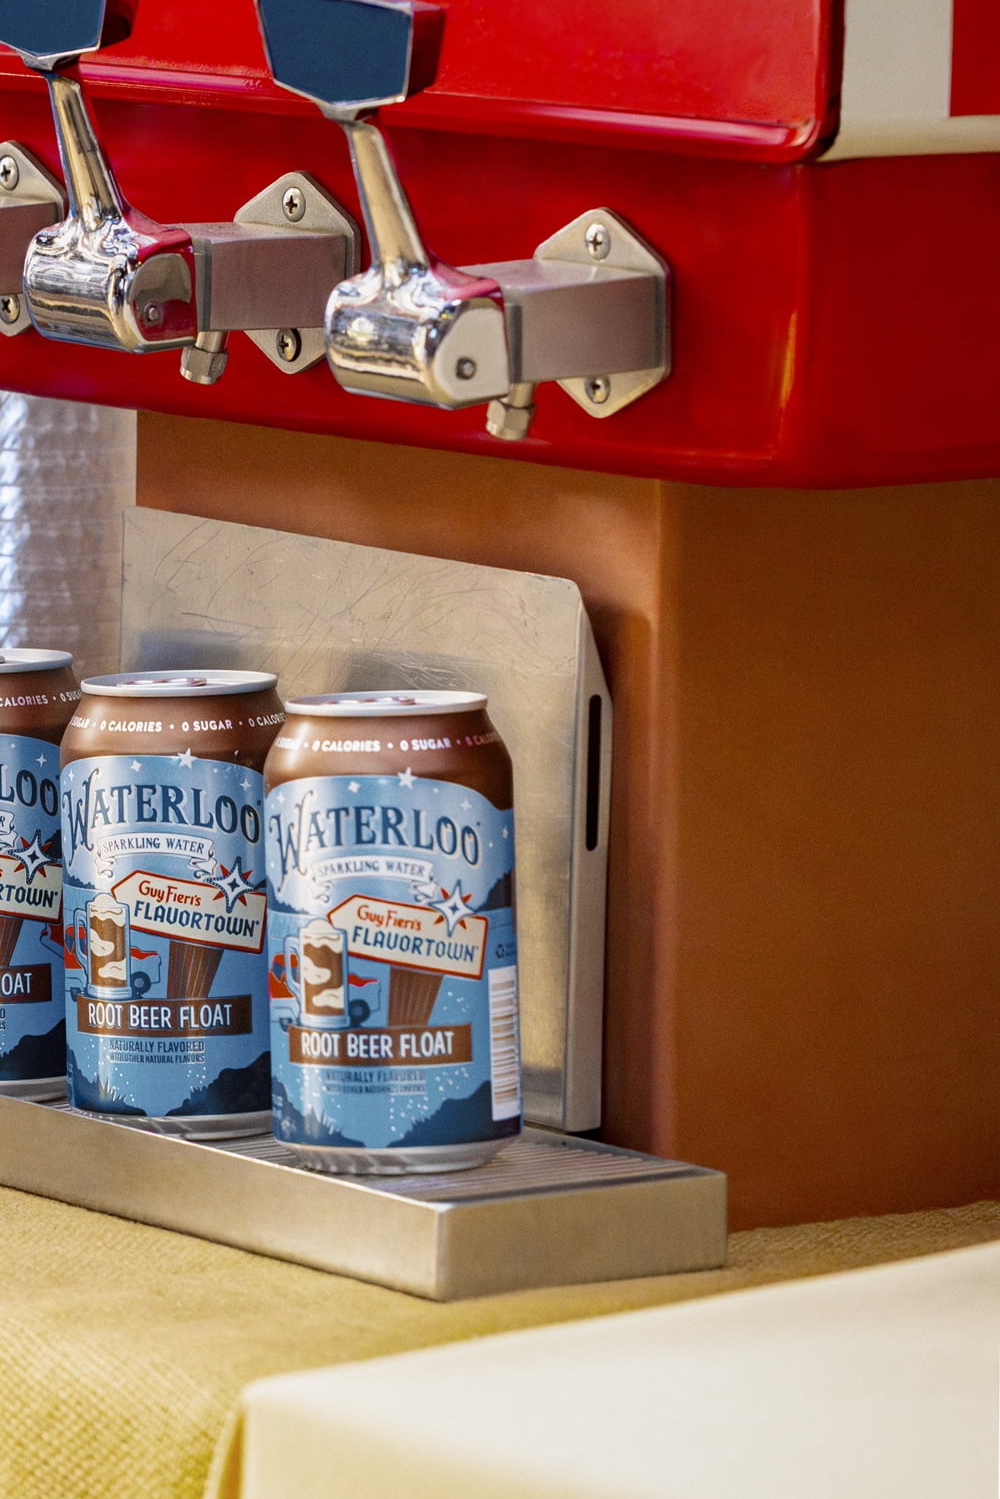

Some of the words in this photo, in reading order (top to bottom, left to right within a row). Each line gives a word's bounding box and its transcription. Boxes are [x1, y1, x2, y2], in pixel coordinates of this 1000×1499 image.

[100, 720, 106, 730] 0
[109, 721, 162, 732] CALORIES
[182, 721, 189, 731] 0
[193, 720, 233, 731] SUGAR
[248, 718, 255, 727] 0
[321, 740, 381, 751] CALORIES
[412, 738, 452, 750] SUGAR
[62, 767, 260, 867] WATERLOO
[103, 837, 160, 852] SPARKLING
[166, 838, 204, 854] WATER
[269, 790, 481, 895] WATERLOO
[318, 860, 380, 877] SPARKLING
[386, 861, 426, 876] WATER
[138, 880, 165, 899] Guy
[357, 905, 383, 926] Guy
[88, 1003, 123, 1028] ROOT
[129, 1004, 172, 1028] BEER
[179, 1003, 232, 1028] FLOAT
[110, 1041, 154, 1052] NATURALLY
[157, 1041, 204, 1052] FLAVORED
[302, 1032, 340, 1058] ROOT
[347, 1033, 393, 1059] BEER
[400, 1031, 454, 1058] FLOAT
[145, 1055, 174, 1063] NATURAL
